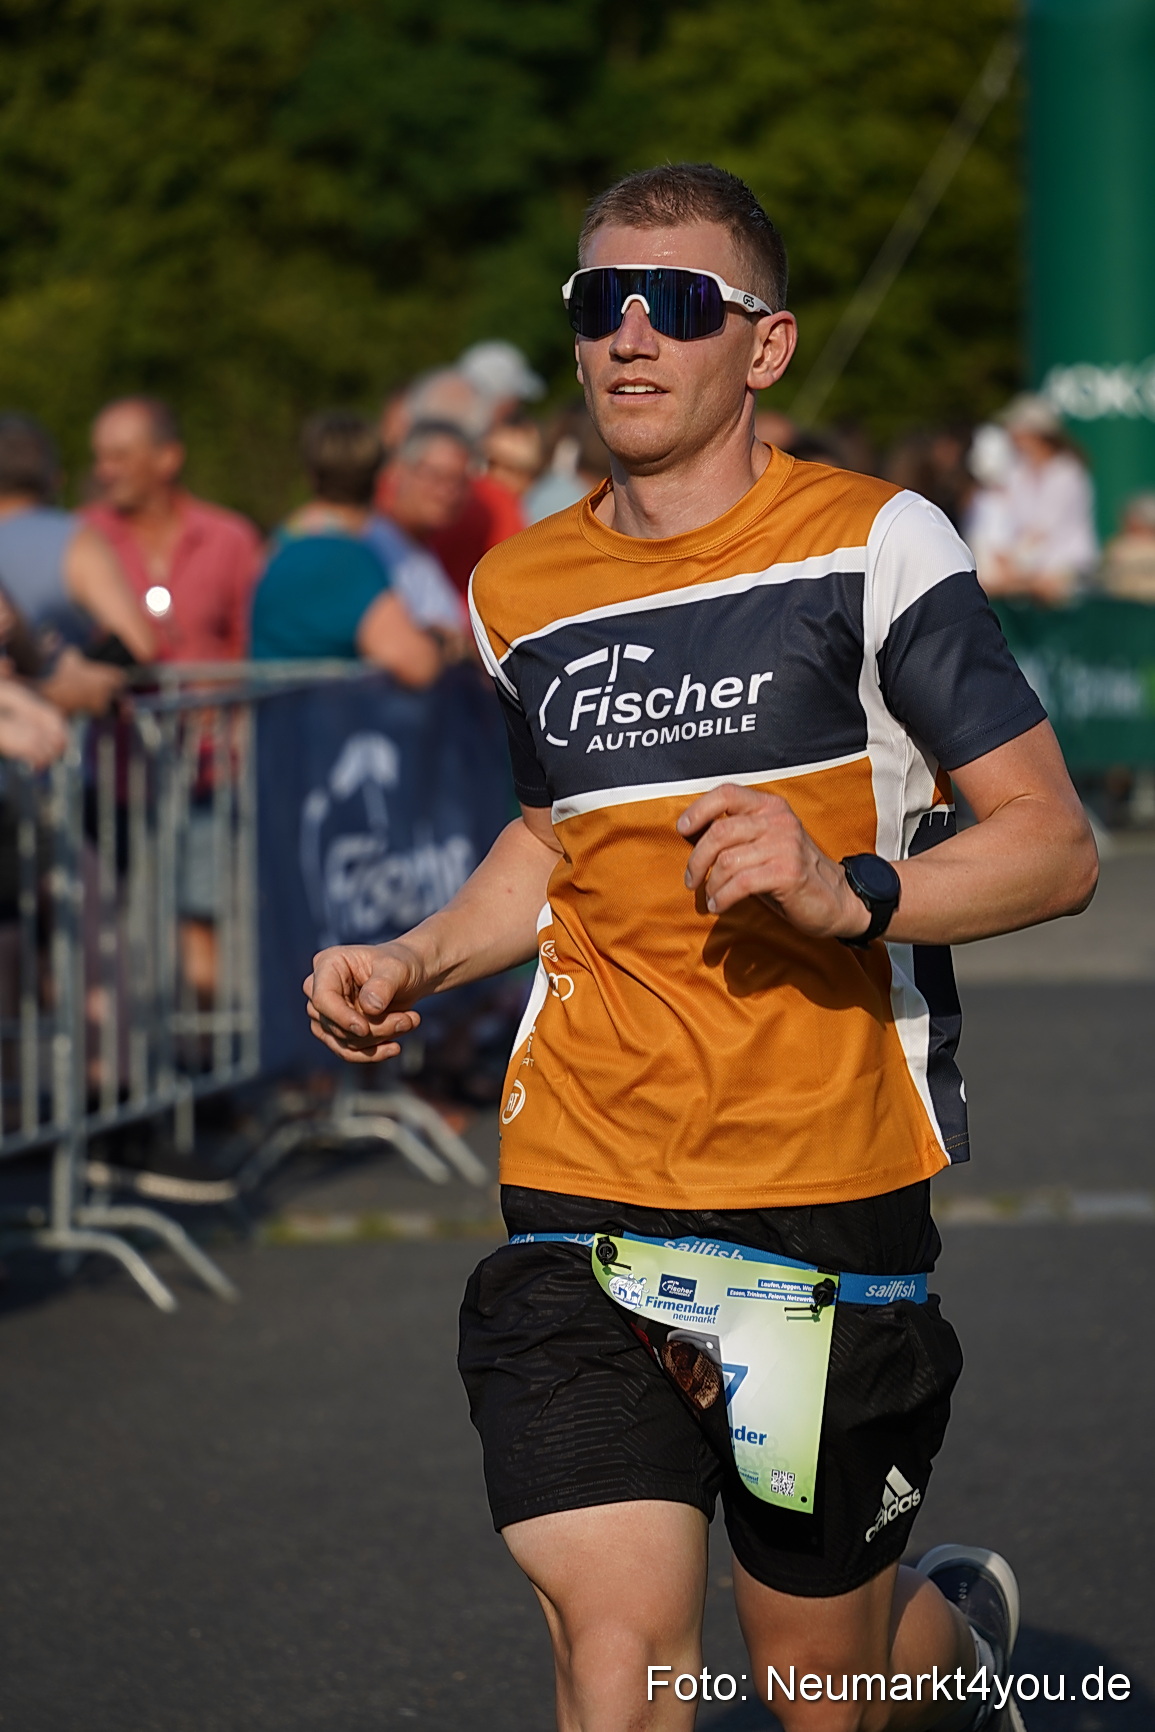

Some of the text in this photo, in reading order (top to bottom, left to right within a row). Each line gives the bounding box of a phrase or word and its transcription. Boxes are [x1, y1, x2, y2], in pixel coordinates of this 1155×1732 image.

[569, 671, 774, 732] Fischer
[585, 713, 757, 754] AUTOMOBILE
[645, 1295, 721, 1316] Firmenlauf
[864, 1280, 916, 1303] sailfish
[672, 1312, 717, 1325] neumarkt
[864, 1487, 921, 1543] adidas
